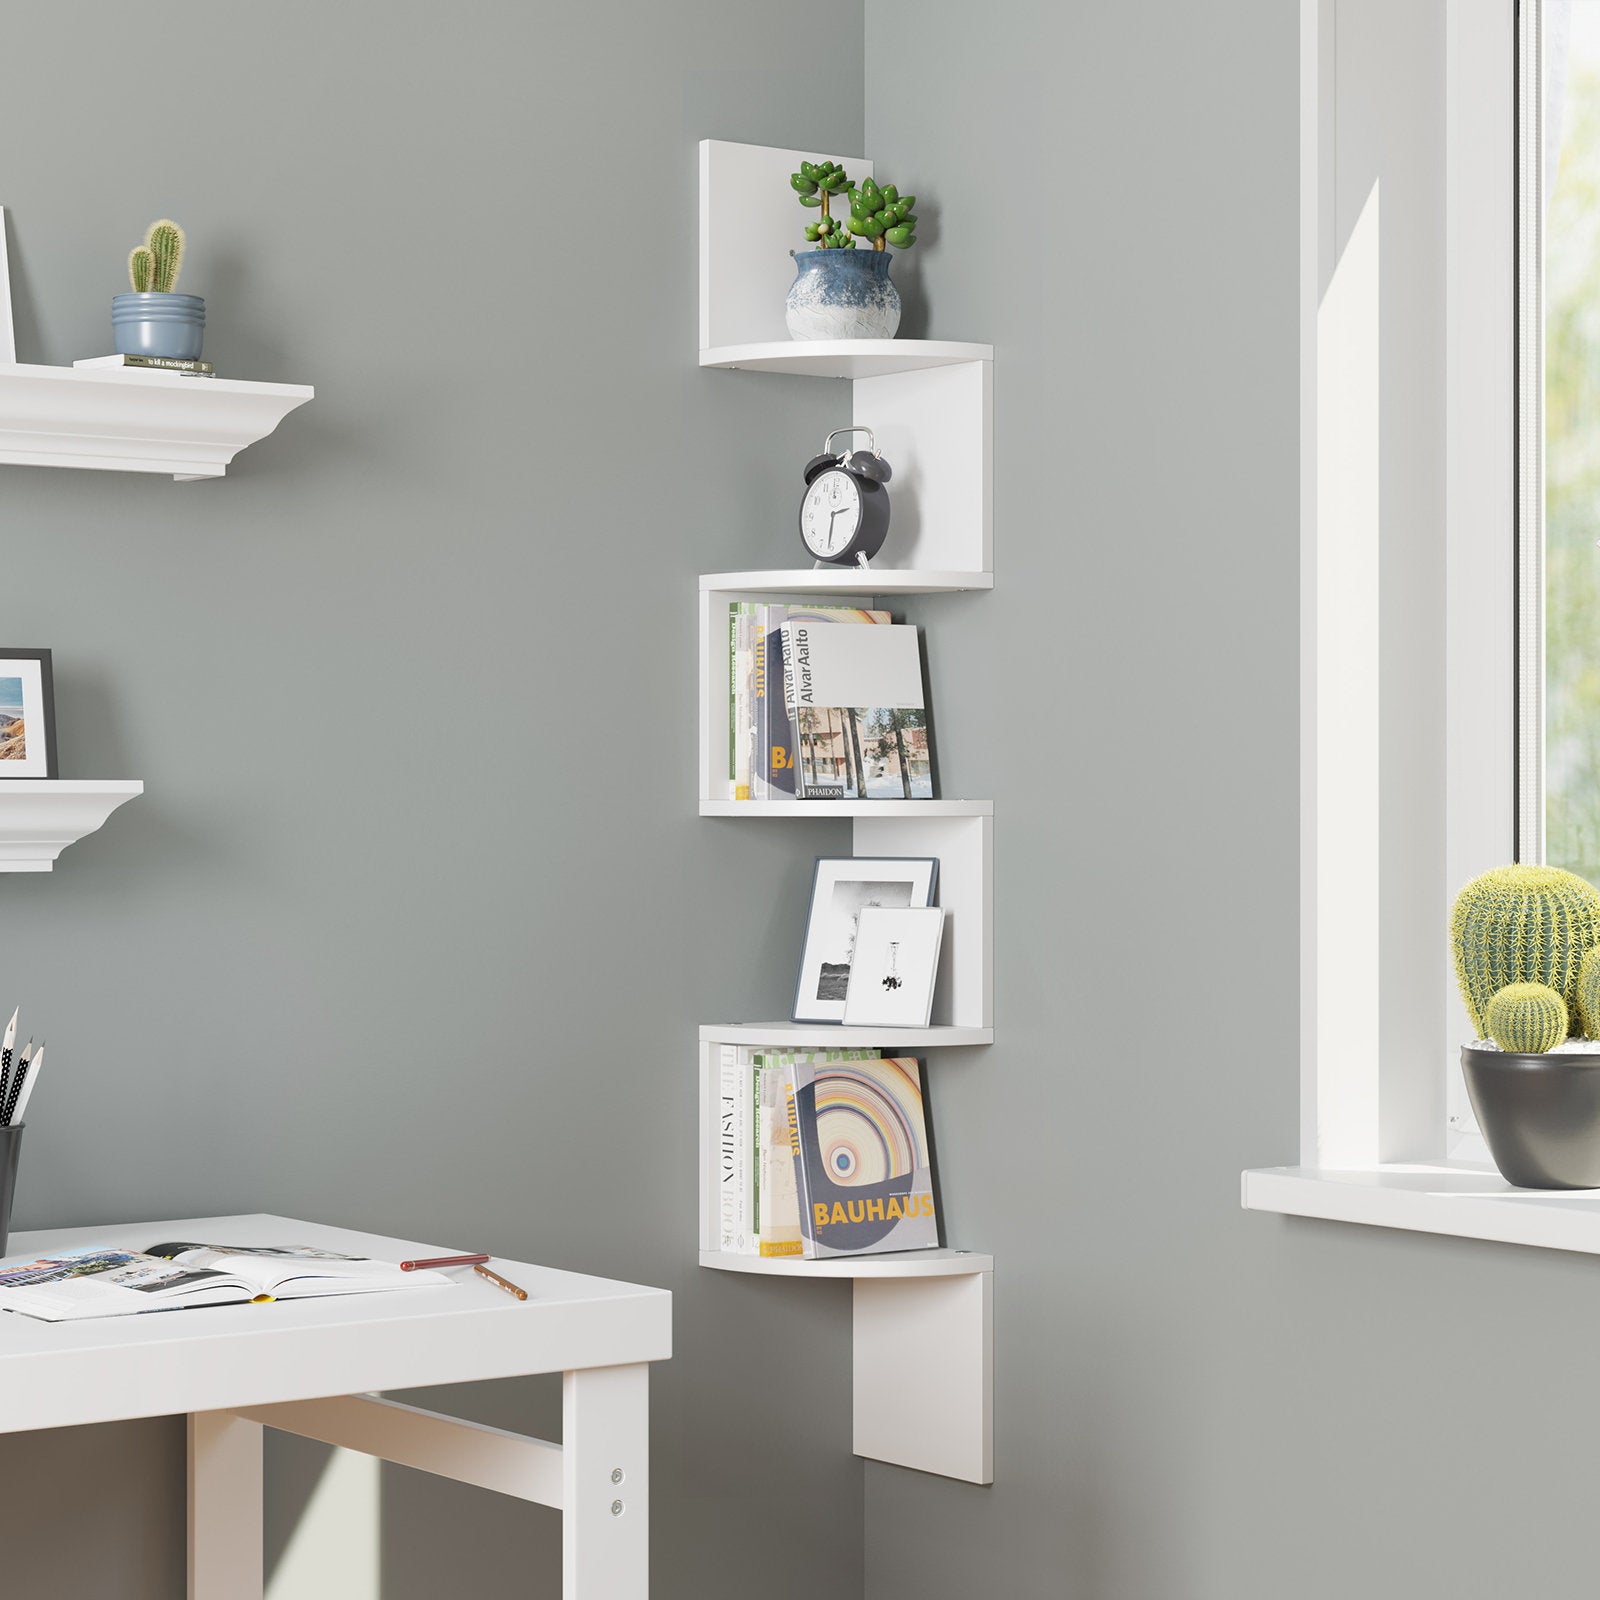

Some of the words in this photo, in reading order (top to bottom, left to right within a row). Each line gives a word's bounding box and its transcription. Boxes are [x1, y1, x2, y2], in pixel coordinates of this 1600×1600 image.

[166, 361, 194, 369] mockingbird
[807, 788, 843, 796] PHAIDON
[722, 1096, 735, 1183] FASHION
[814, 1194, 934, 1225] BAUHAUS
